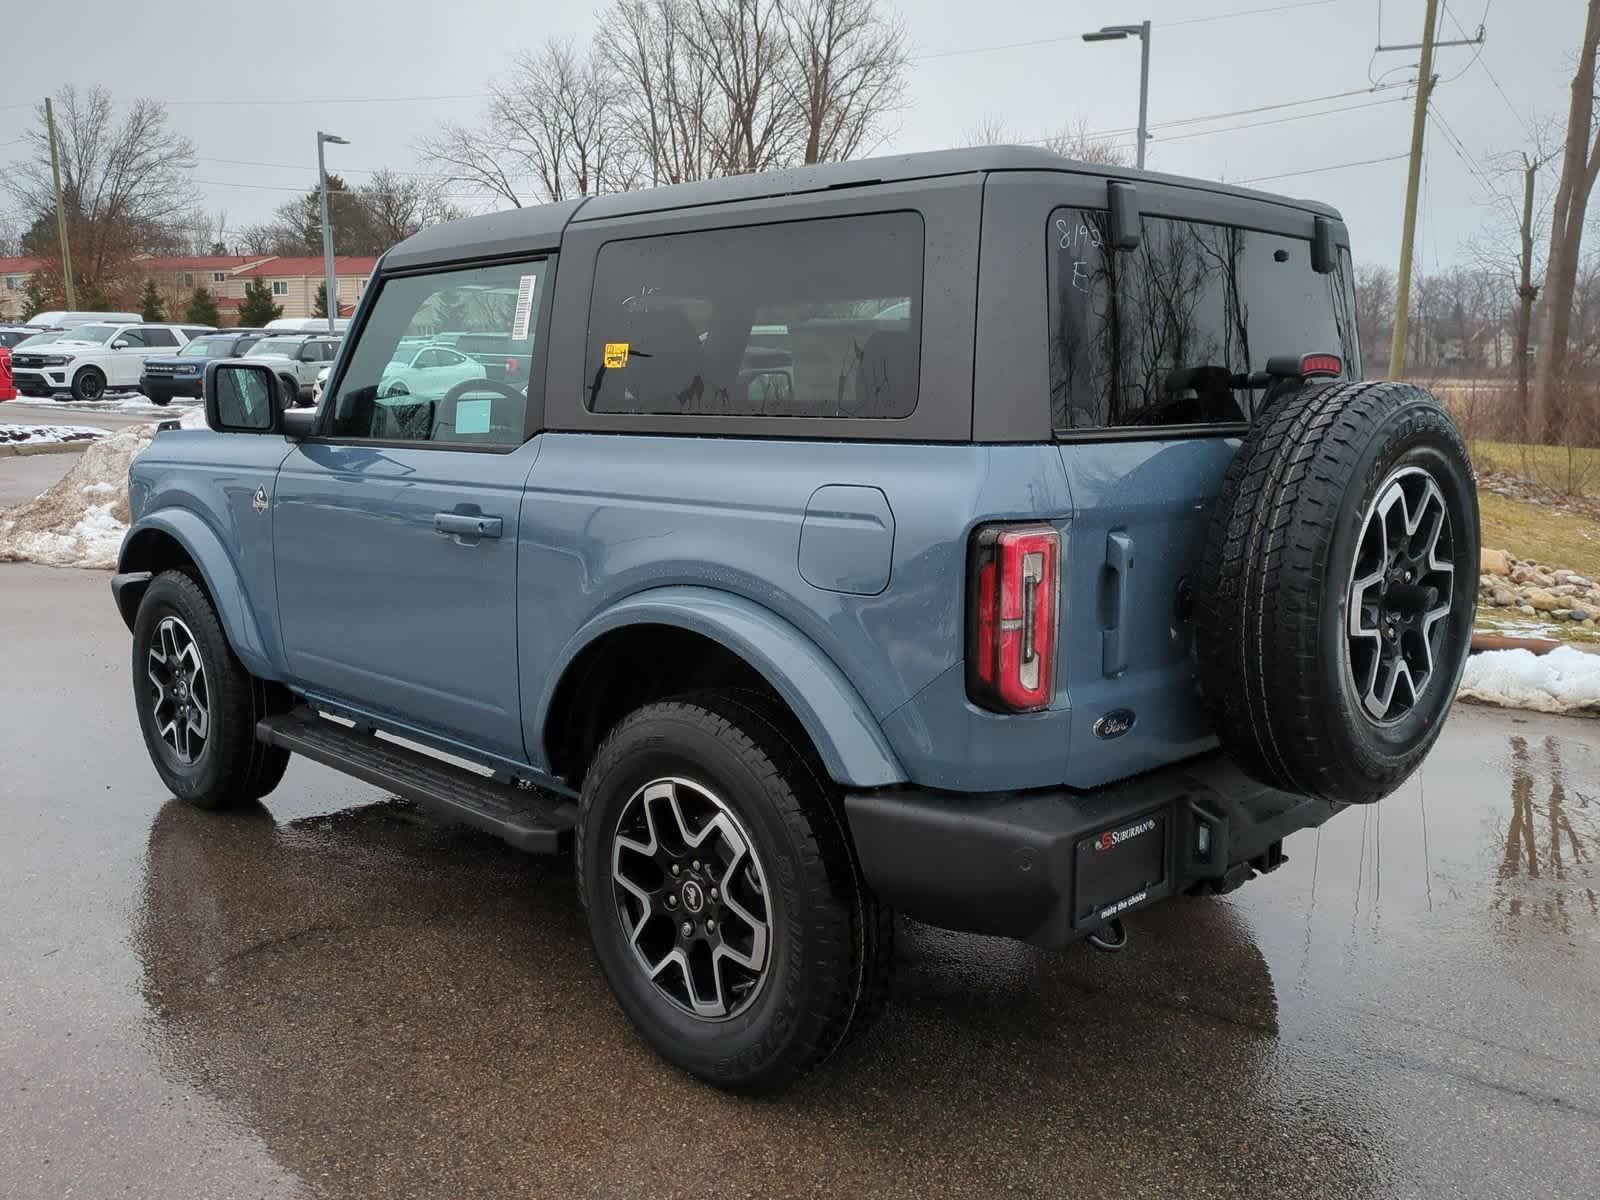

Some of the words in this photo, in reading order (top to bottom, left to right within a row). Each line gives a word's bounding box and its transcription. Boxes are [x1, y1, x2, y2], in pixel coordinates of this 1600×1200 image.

[1101, 906, 1117, 920] make
[1117, 900, 1128, 911] the
[1128, 892, 1147, 906] choice
